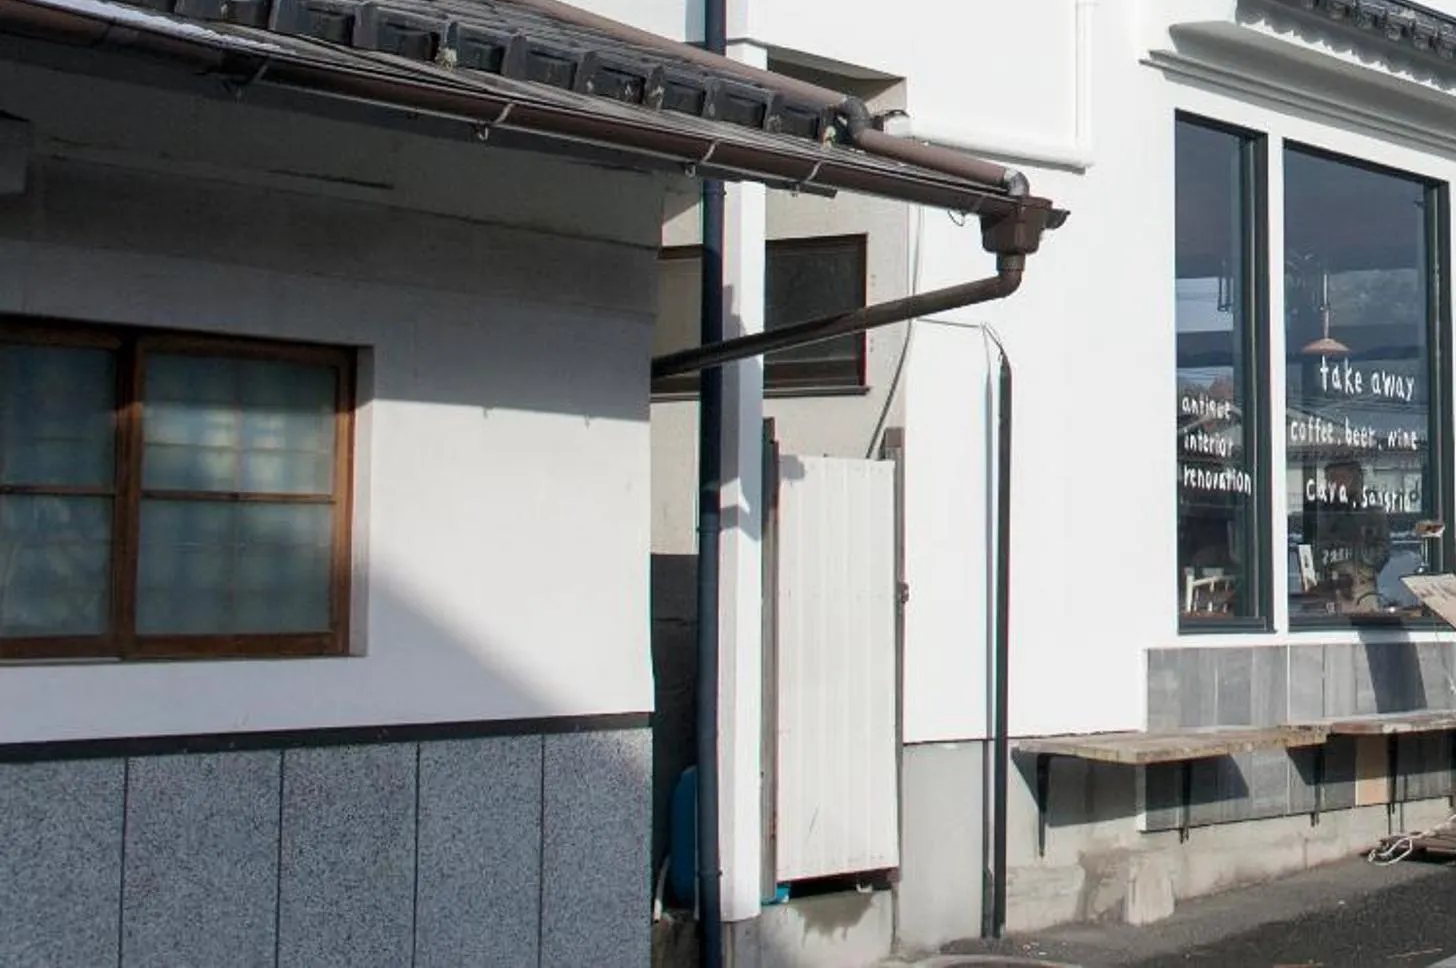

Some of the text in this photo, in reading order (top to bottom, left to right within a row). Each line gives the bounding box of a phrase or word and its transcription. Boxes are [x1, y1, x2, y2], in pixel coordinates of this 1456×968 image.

[1320, 355, 1415, 401] take away
[1183, 428, 1233, 457] interior
[1183, 465, 1252, 496] renovation
